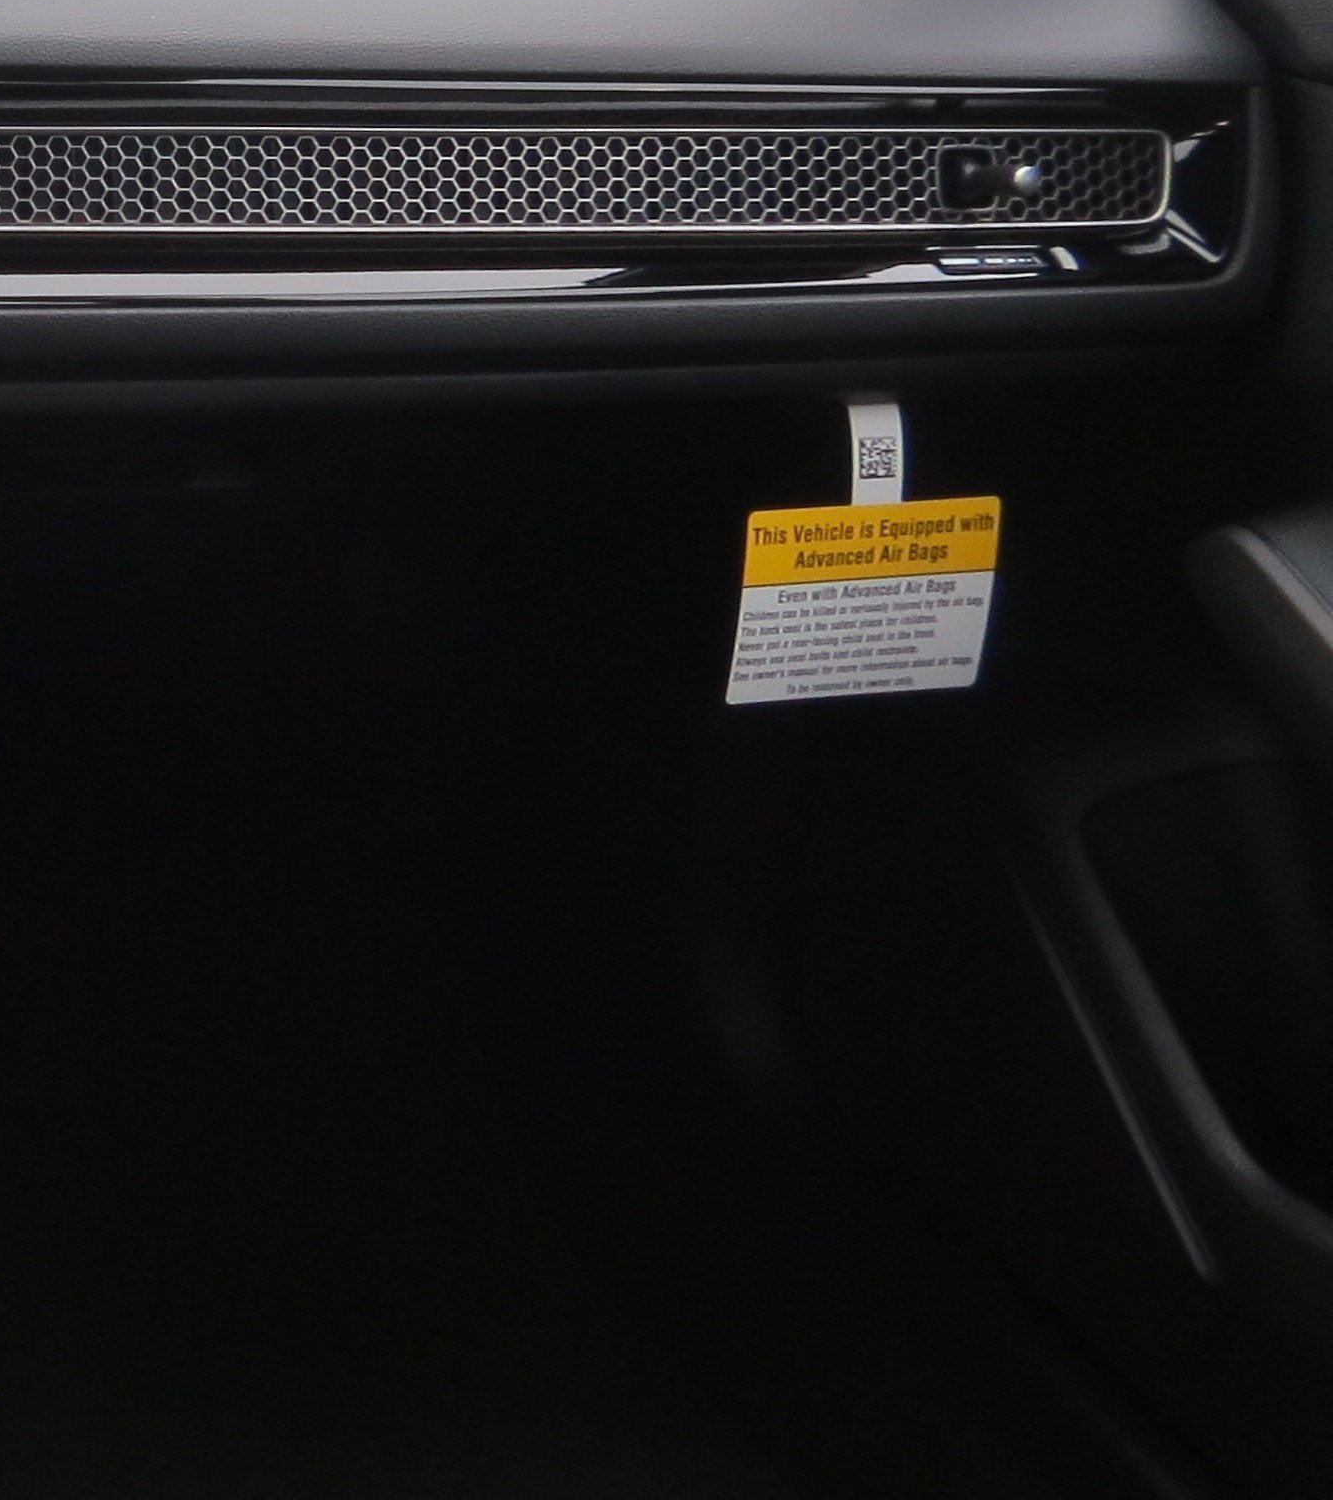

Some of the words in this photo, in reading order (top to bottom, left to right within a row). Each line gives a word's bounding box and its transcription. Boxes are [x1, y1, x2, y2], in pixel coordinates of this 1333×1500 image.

[751, 526, 788, 546] This
[793, 521, 855, 544] Vehicle
[860, 520, 874, 539] is
[879, 514, 955, 539] Equipped
[960, 512, 995, 532] with
[794, 547, 875, 569] Advanced
[880, 545, 903, 563] Air
[908, 543, 949, 563] Bags
[778, 589, 808, 604] Even
[812, 587, 838, 600] with
[839, 583, 902, 599] Advanced
[905, 580, 923, 594] Air
[926, 579, 957, 595] Bags
